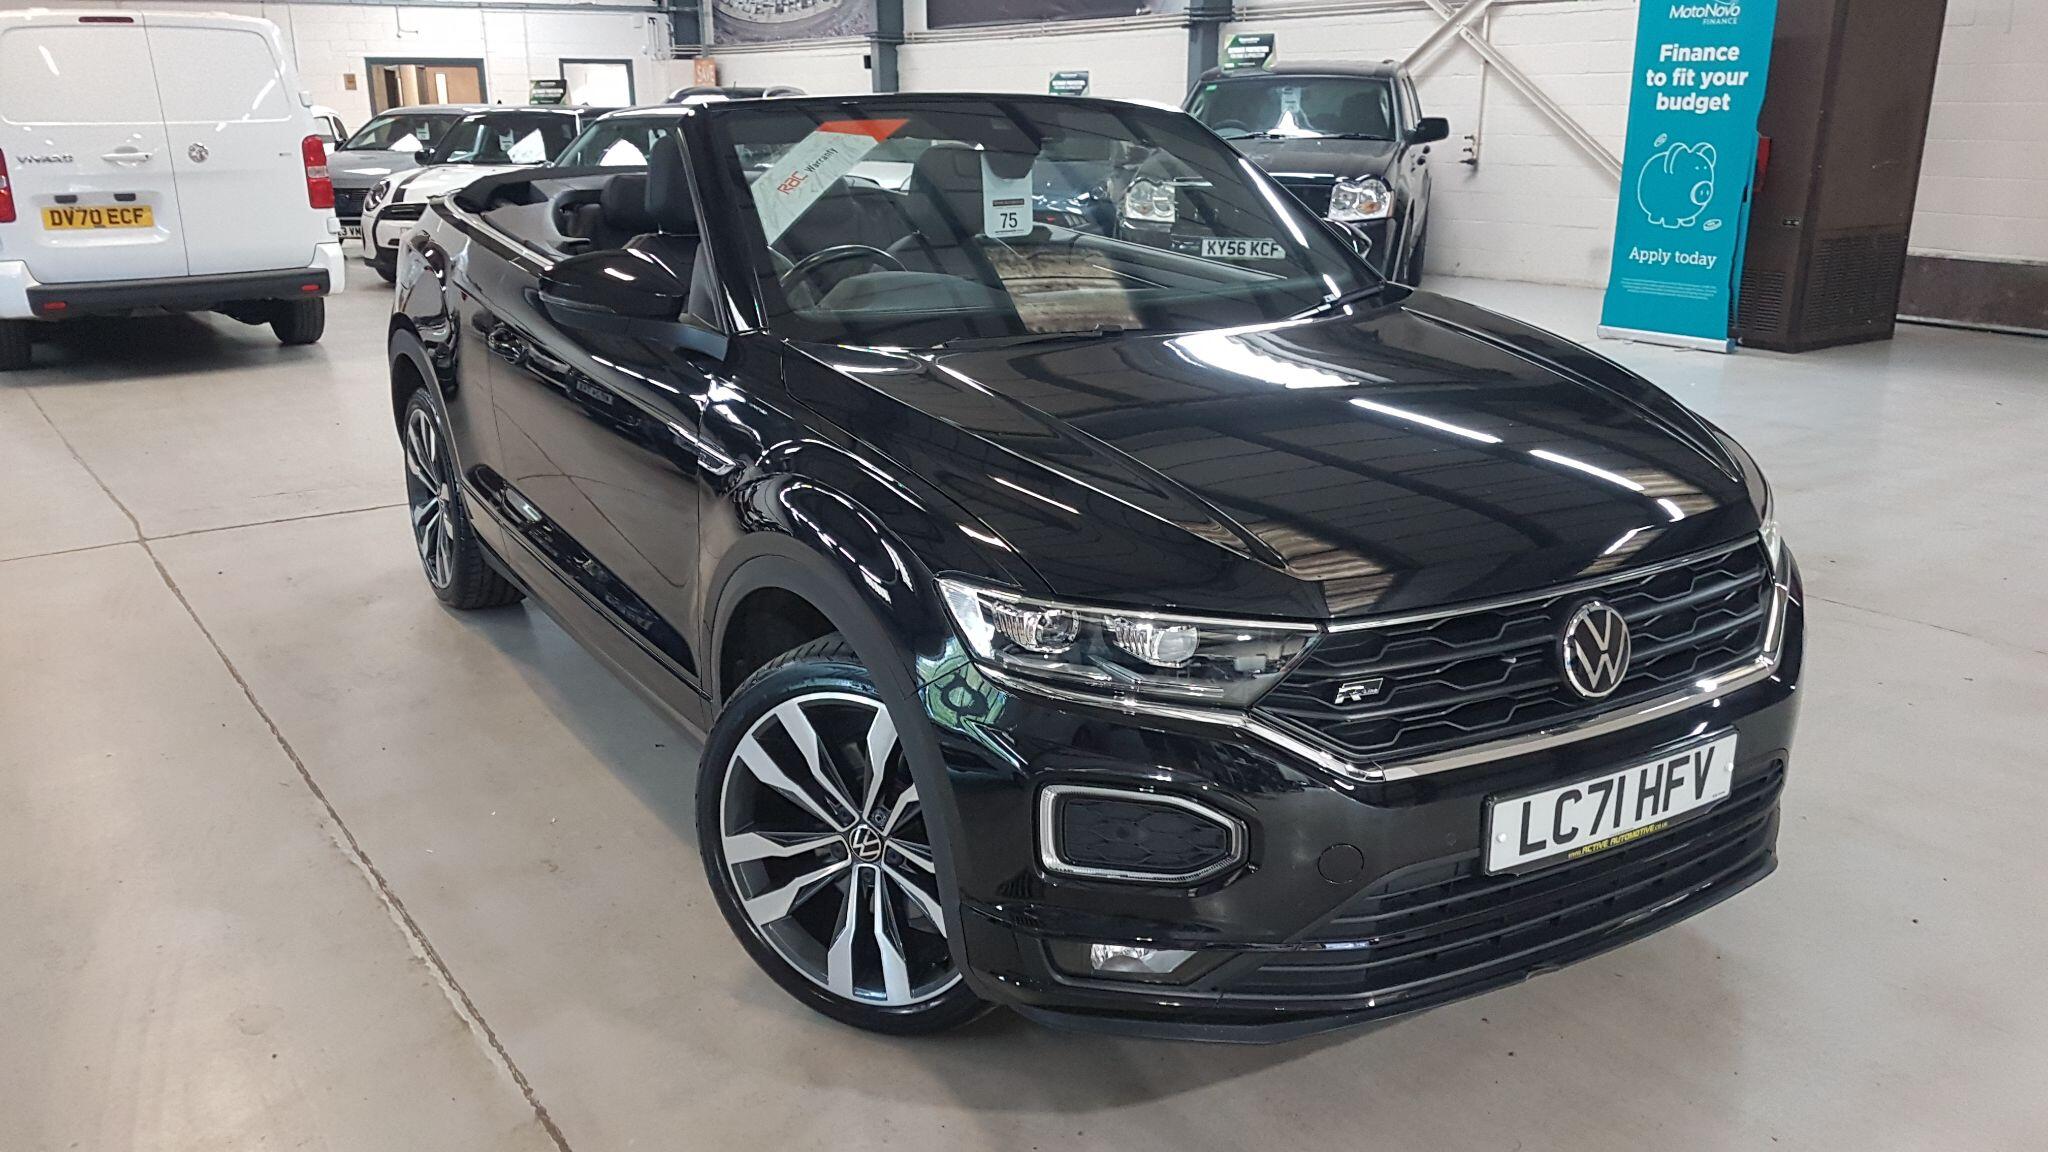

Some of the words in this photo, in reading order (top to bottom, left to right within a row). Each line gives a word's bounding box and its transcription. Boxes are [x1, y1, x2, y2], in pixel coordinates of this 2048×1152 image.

[1669, 3, 1741, 19] MotoNovo
[1659, 43, 1740, 62] Finance
[1646, 69, 1667, 87] to
[1672, 67, 1696, 87] fit
[1699, 71, 1749, 90] your
[1655, 92, 1731, 114] budget
[804, 147, 839, 173] Warranty
[49, 209, 102, 227] DV70
[107, 208, 144, 225] ECF
[1000, 212, 1018, 229] 75
[1207, 240, 1246, 256] KY56
[1249, 241, 1279, 257] KCF
[1628, 246, 1671, 266] Apply
[1675, 251, 1718, 270] today
[1518, 775, 1626, 857] LC71
[1634, 745, 1716, 823] HFV
